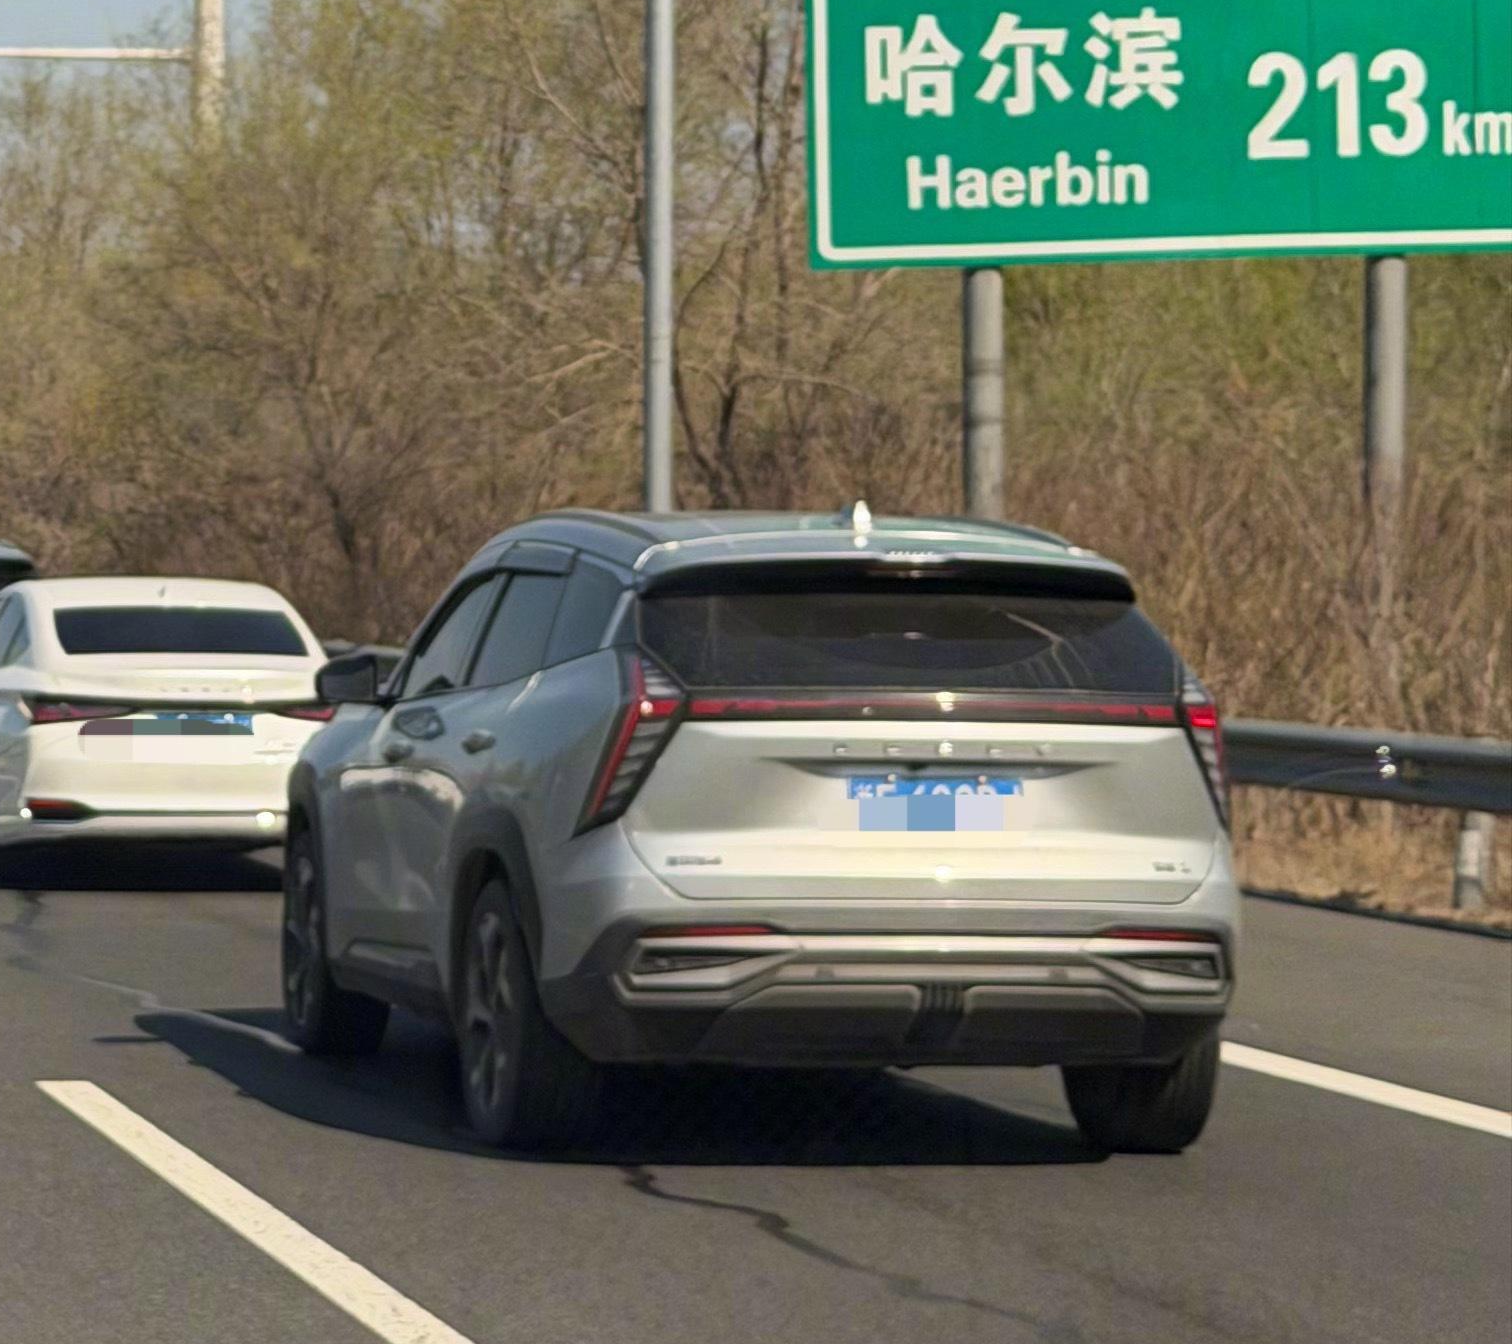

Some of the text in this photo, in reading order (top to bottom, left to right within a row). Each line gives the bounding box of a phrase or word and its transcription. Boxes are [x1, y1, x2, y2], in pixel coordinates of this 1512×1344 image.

[864, 6, 1512, 160] 哈尔滨 213 km
[906, 148, 1149, 210] Haerbin
